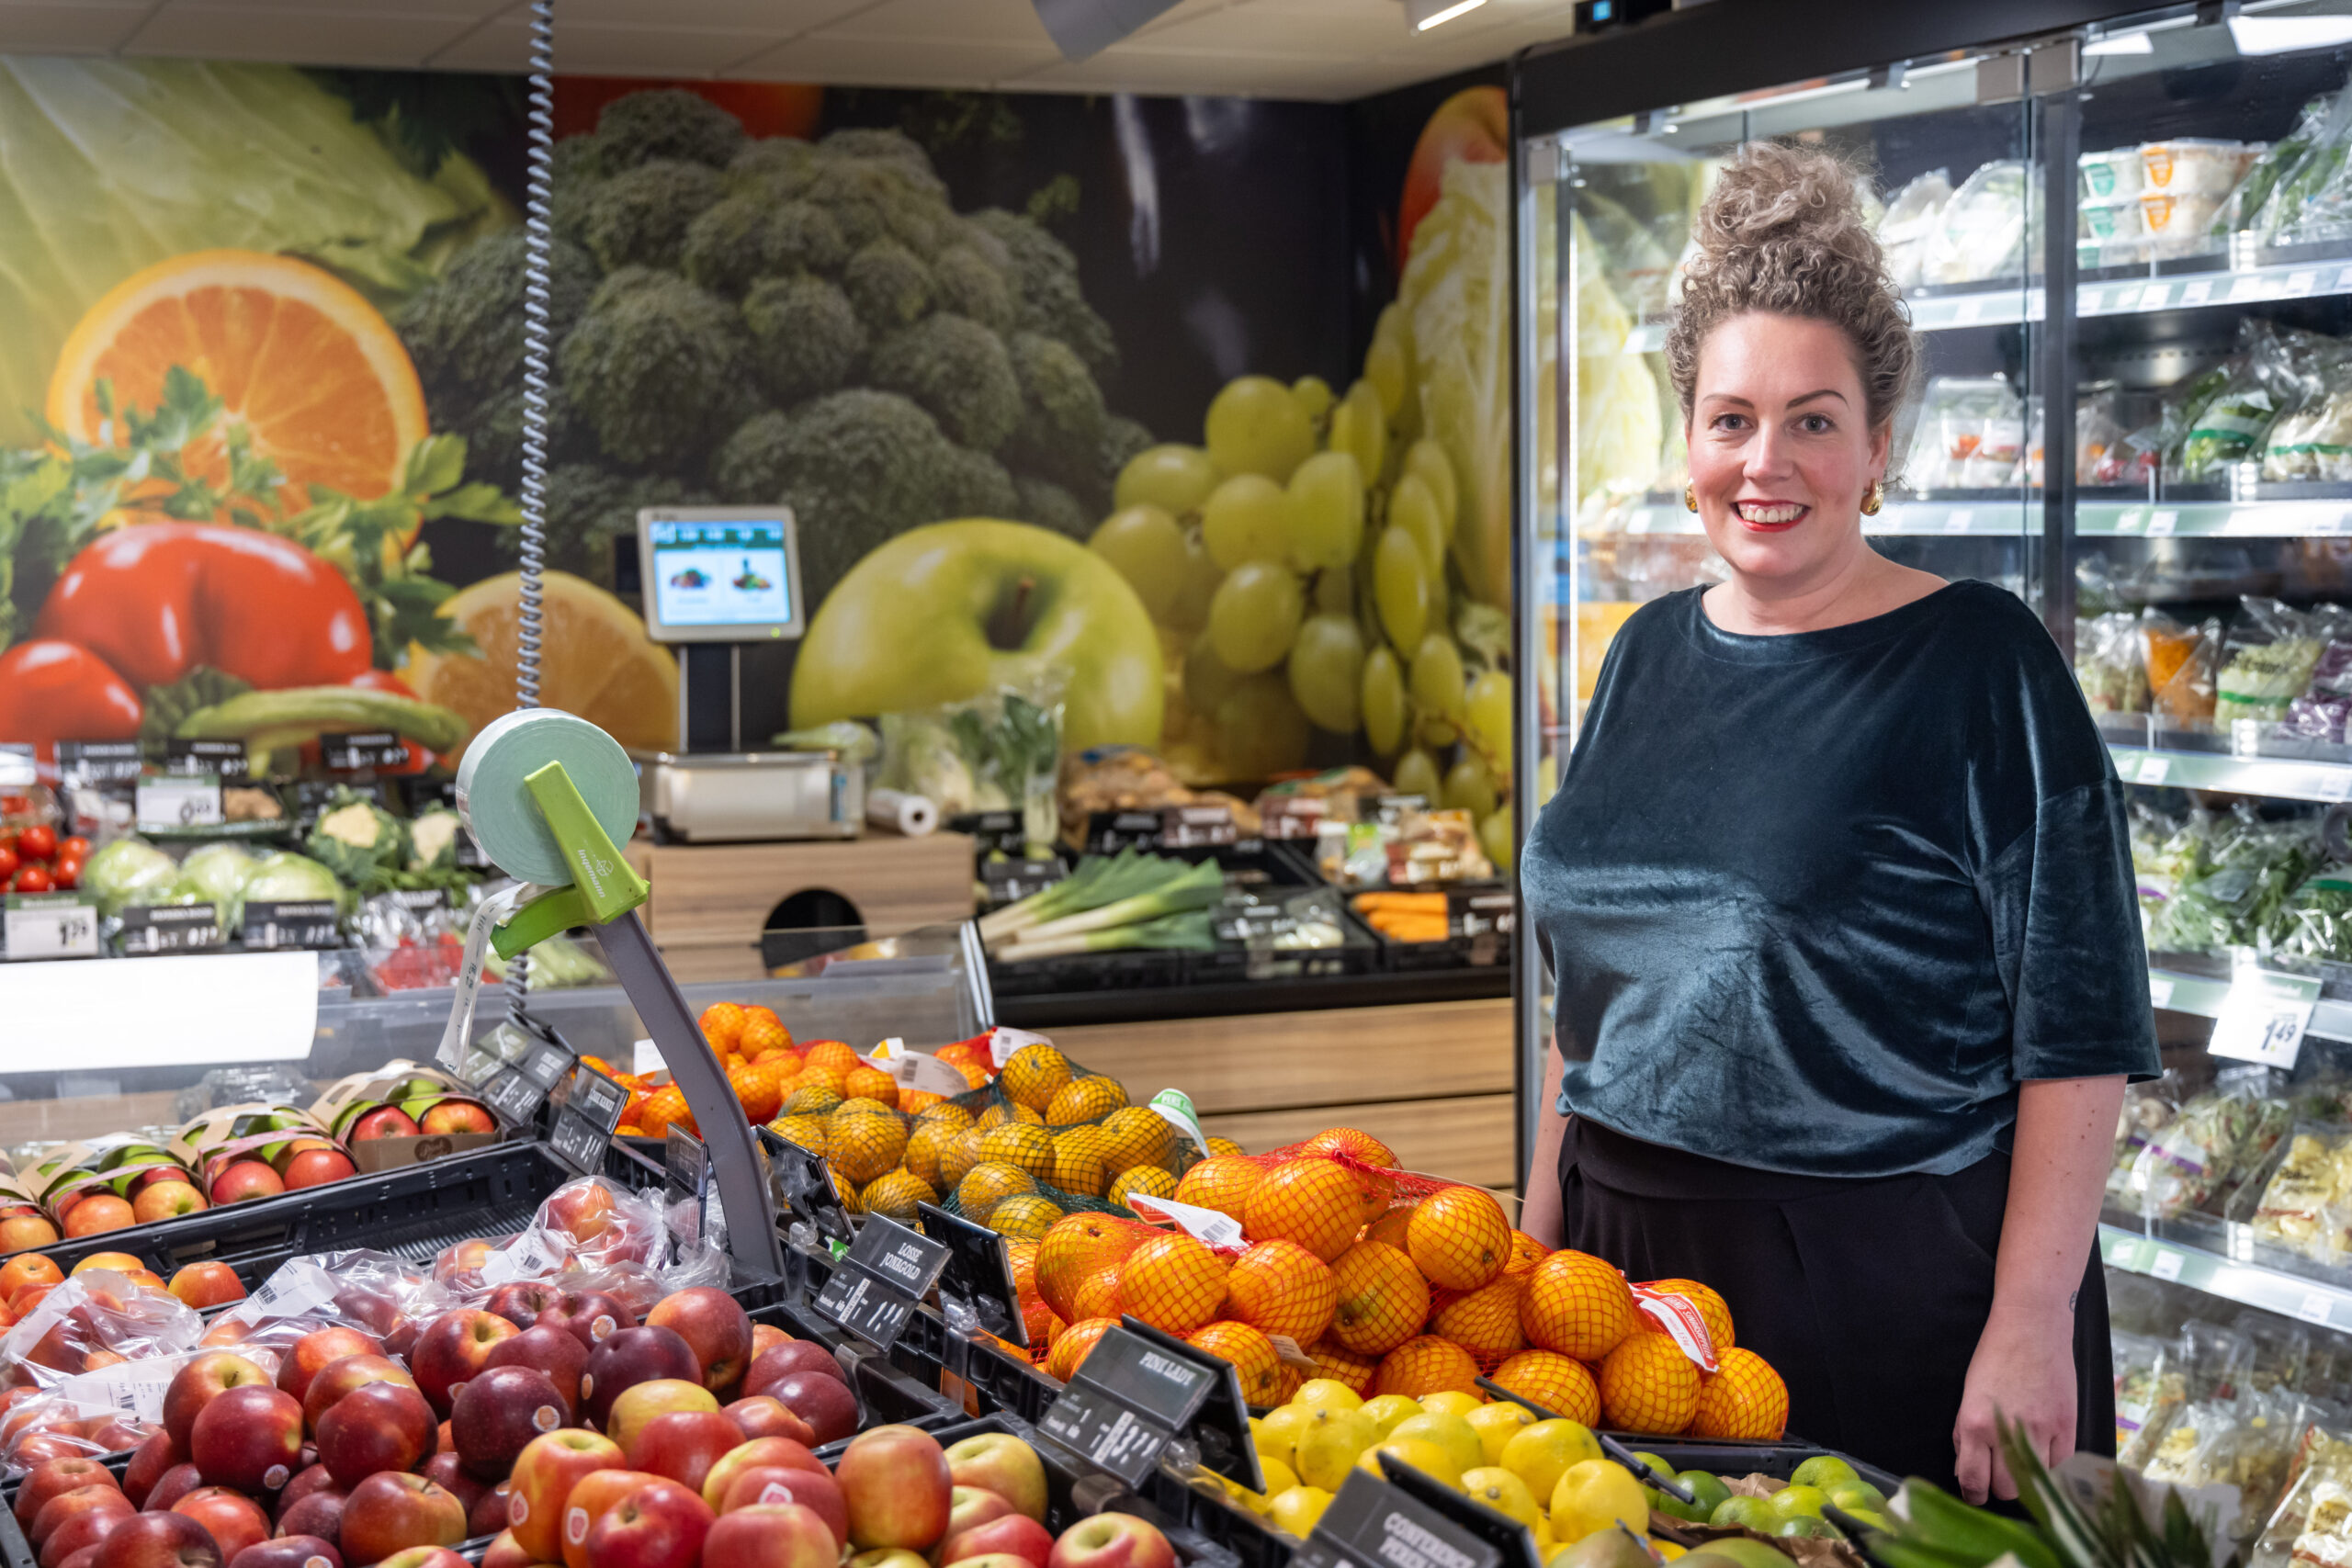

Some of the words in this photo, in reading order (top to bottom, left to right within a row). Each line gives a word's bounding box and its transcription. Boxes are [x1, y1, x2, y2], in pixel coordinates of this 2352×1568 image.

[577, 849, 605, 898] Ingemann
[879, 1252, 921, 1280] JONAGOLD
[898, 1242, 923, 1263] LOSSE
[1138, 1351, 1166, 1374] PINK
[1163, 1361, 1197, 1386] LADY
